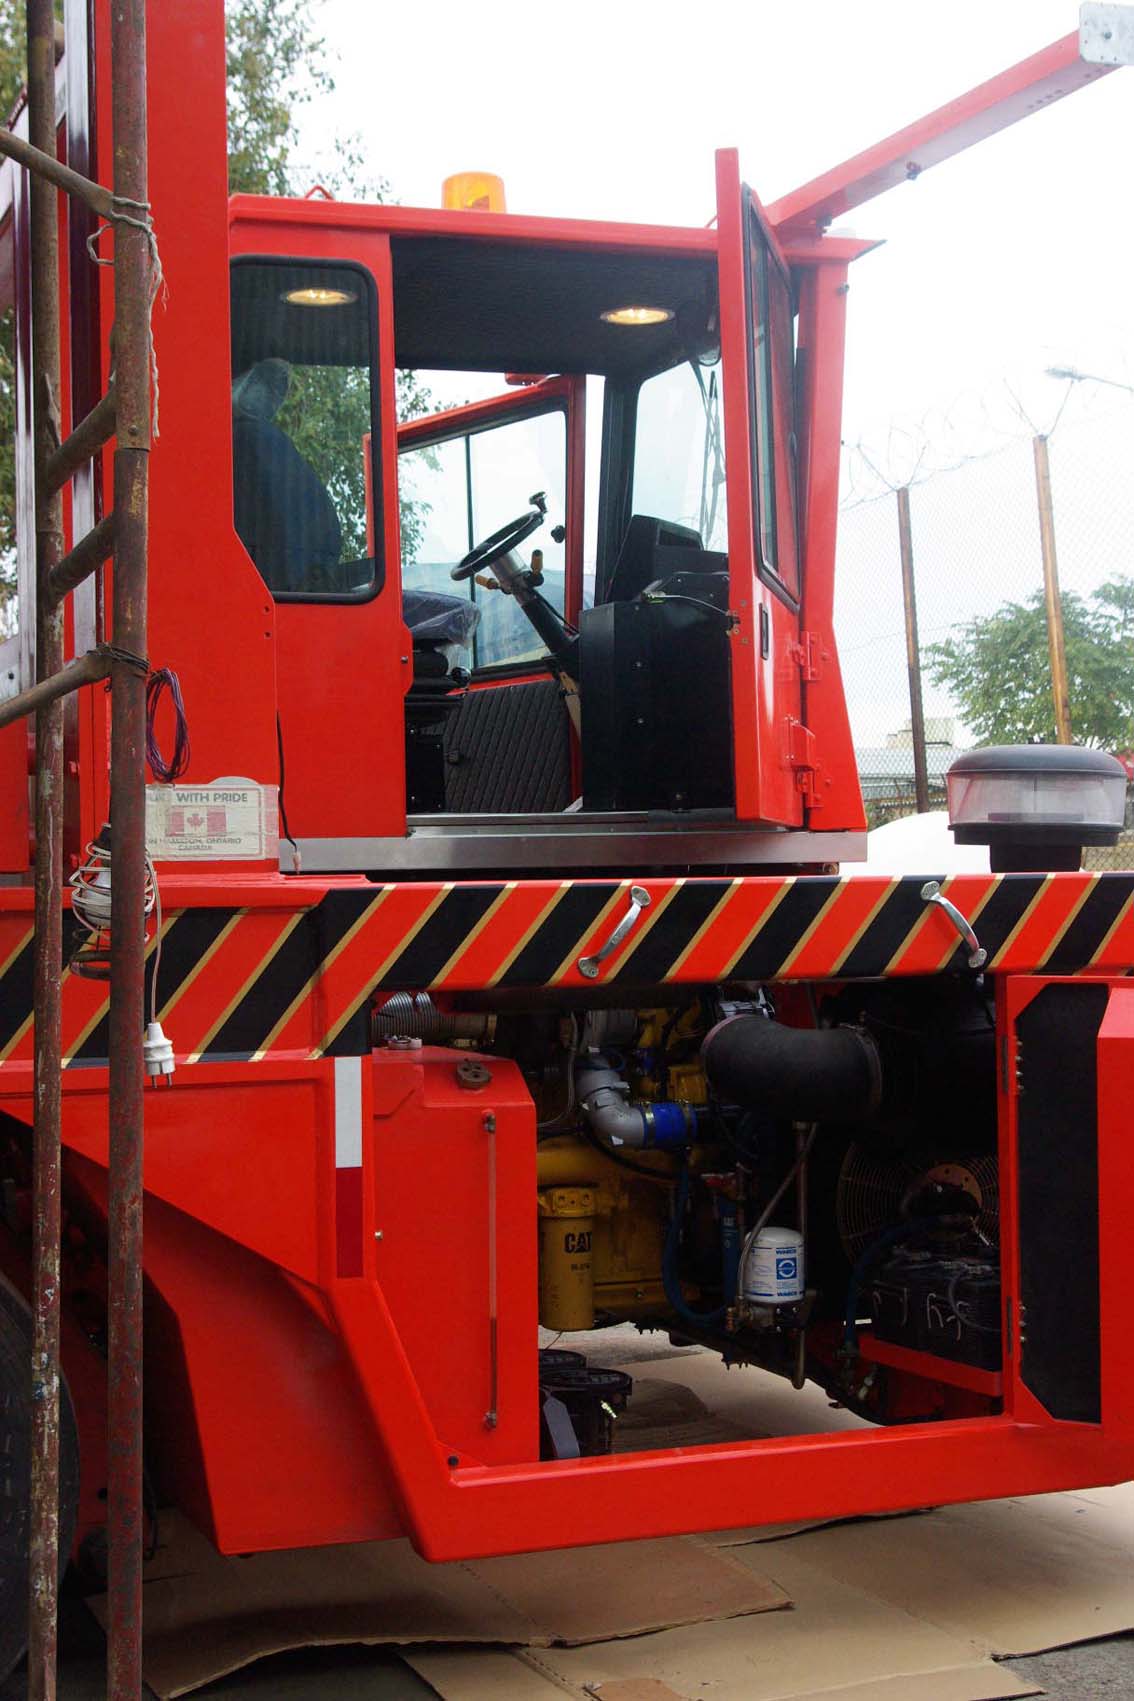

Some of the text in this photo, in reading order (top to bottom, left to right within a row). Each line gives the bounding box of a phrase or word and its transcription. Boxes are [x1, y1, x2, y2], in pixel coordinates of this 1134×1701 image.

[176, 792, 209, 802] WITH
[213, 792, 248, 802] PRIDE
[564, 1232, 592, 1254] CAT
